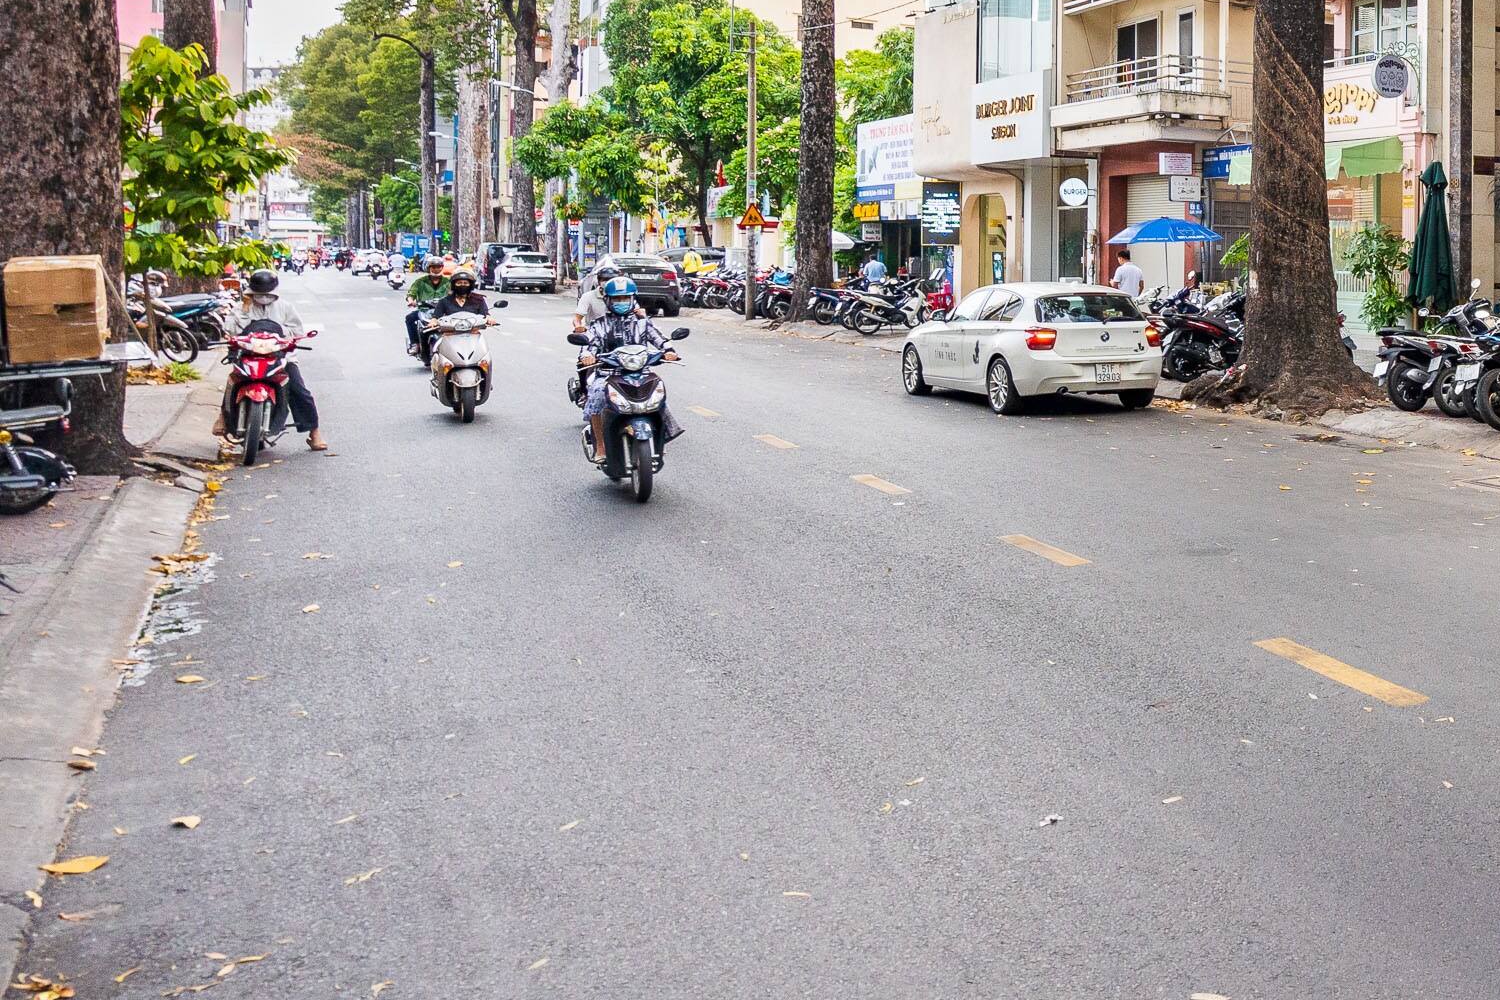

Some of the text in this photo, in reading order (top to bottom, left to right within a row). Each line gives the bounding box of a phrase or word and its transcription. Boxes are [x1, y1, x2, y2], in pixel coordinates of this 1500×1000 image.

[976, 94, 1035, 120] BURGER JOINT
[991, 123, 1017, 140] SAIGON
[1063, 188, 1087, 196] BURGER
[1101, 364, 1115, 373] 51F
